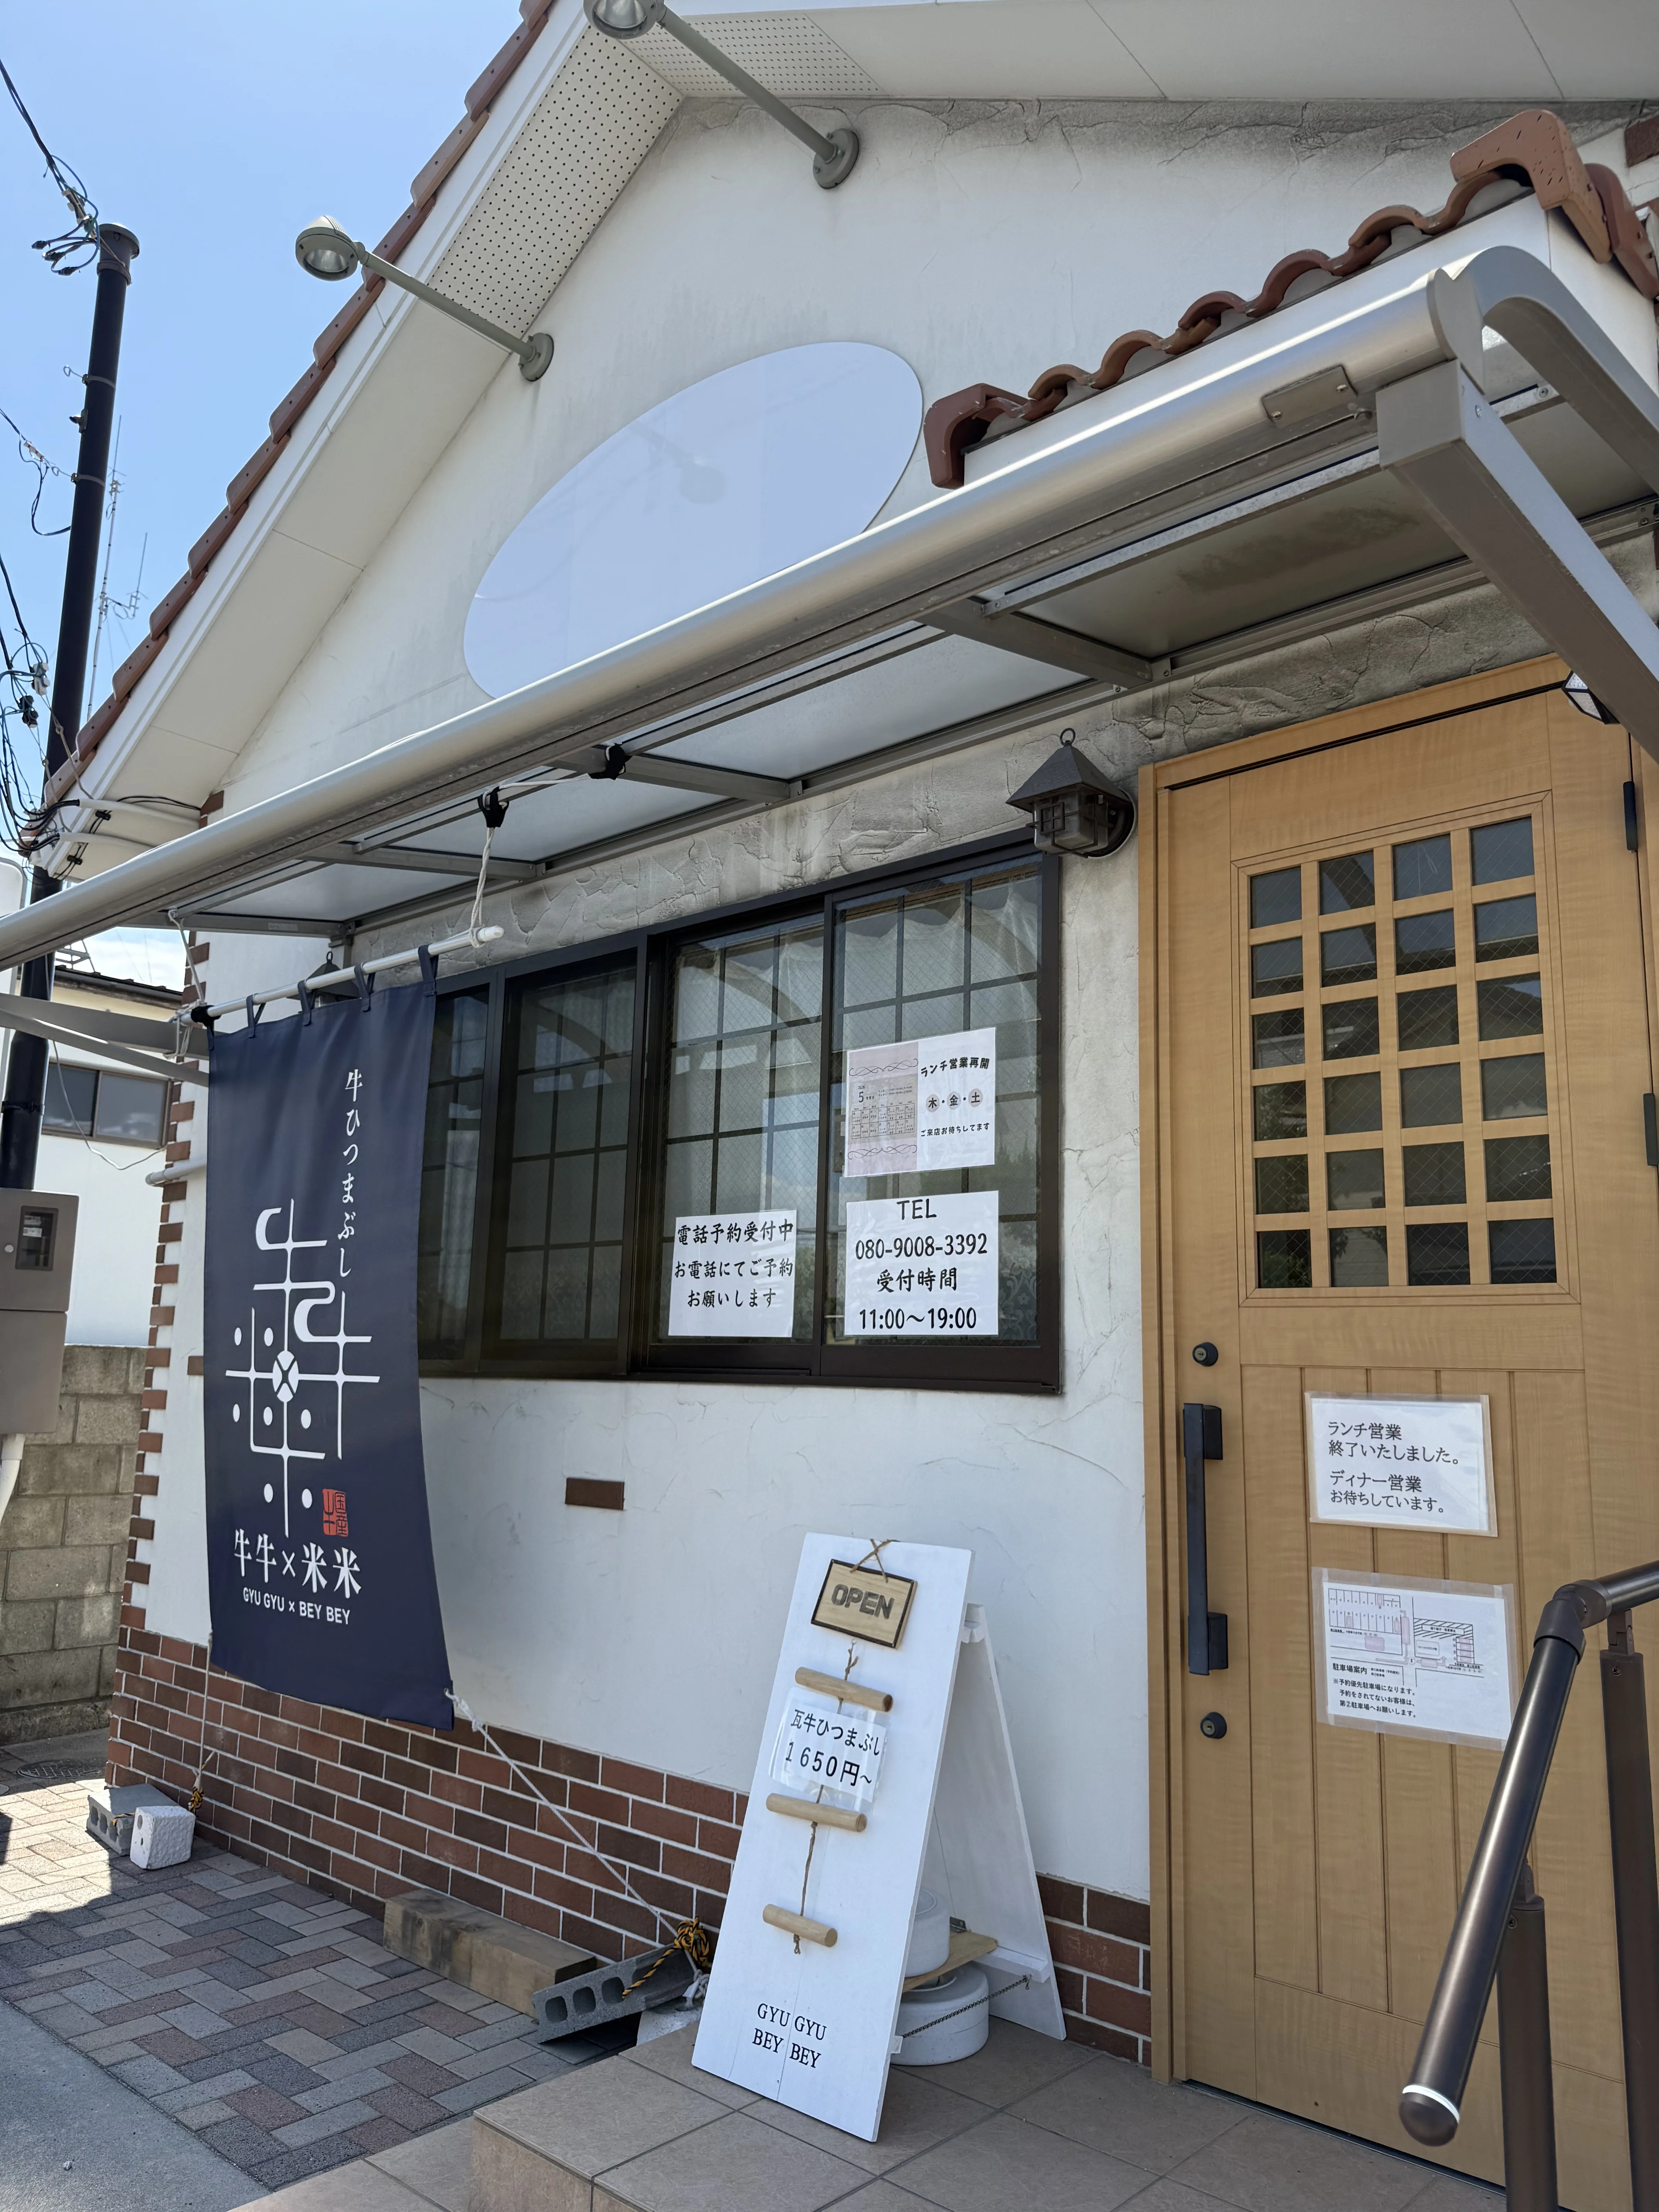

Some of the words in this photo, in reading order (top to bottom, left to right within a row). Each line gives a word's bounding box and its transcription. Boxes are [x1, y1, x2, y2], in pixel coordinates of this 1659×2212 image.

[921, 1057, 989, 1077] ランチ営業再開
[859, 1091, 864, 1103] 5
[921, 1123, 989, 1137] ご来店お待ちしてます
[338, 1069, 363, 1278] 牛ひつまぶし
[897, 1199, 937, 1220] TEL
[678, 1219, 793, 1245] 電話予約受付中
[855, 1233, 988, 1260] 080-9008-3392
[675, 1258, 792, 1278] お電話にてご予約
[877, 1267, 957, 1293] 受付時間
[687, 1288, 776, 1308] お願いします
[1328, 1421, 1402, 1440] ランチ営業
[1328, 1439, 1458, 1465] 終了いたしました。
[1330, 1470, 1422, 1492] ディナー営業
[1330, 1490, 1444, 1513] お待ちしています。
[243, 1587, 261, 1606] GYU
[263, 1593, 285, 1612] GYU
[299, 1601, 321, 1620] BEY
[326, 1606, 350, 1625] BEY
[831, 1583, 895, 1620] OPEN
[1333, 1663, 1367, 1674] 駐車場案内
[757, 2003, 791, 2027] GYU
[794, 2016, 827, 2040] GYU
[752, 2028, 784, 2053] BEY
[789, 2043, 821, 2068] BEY
